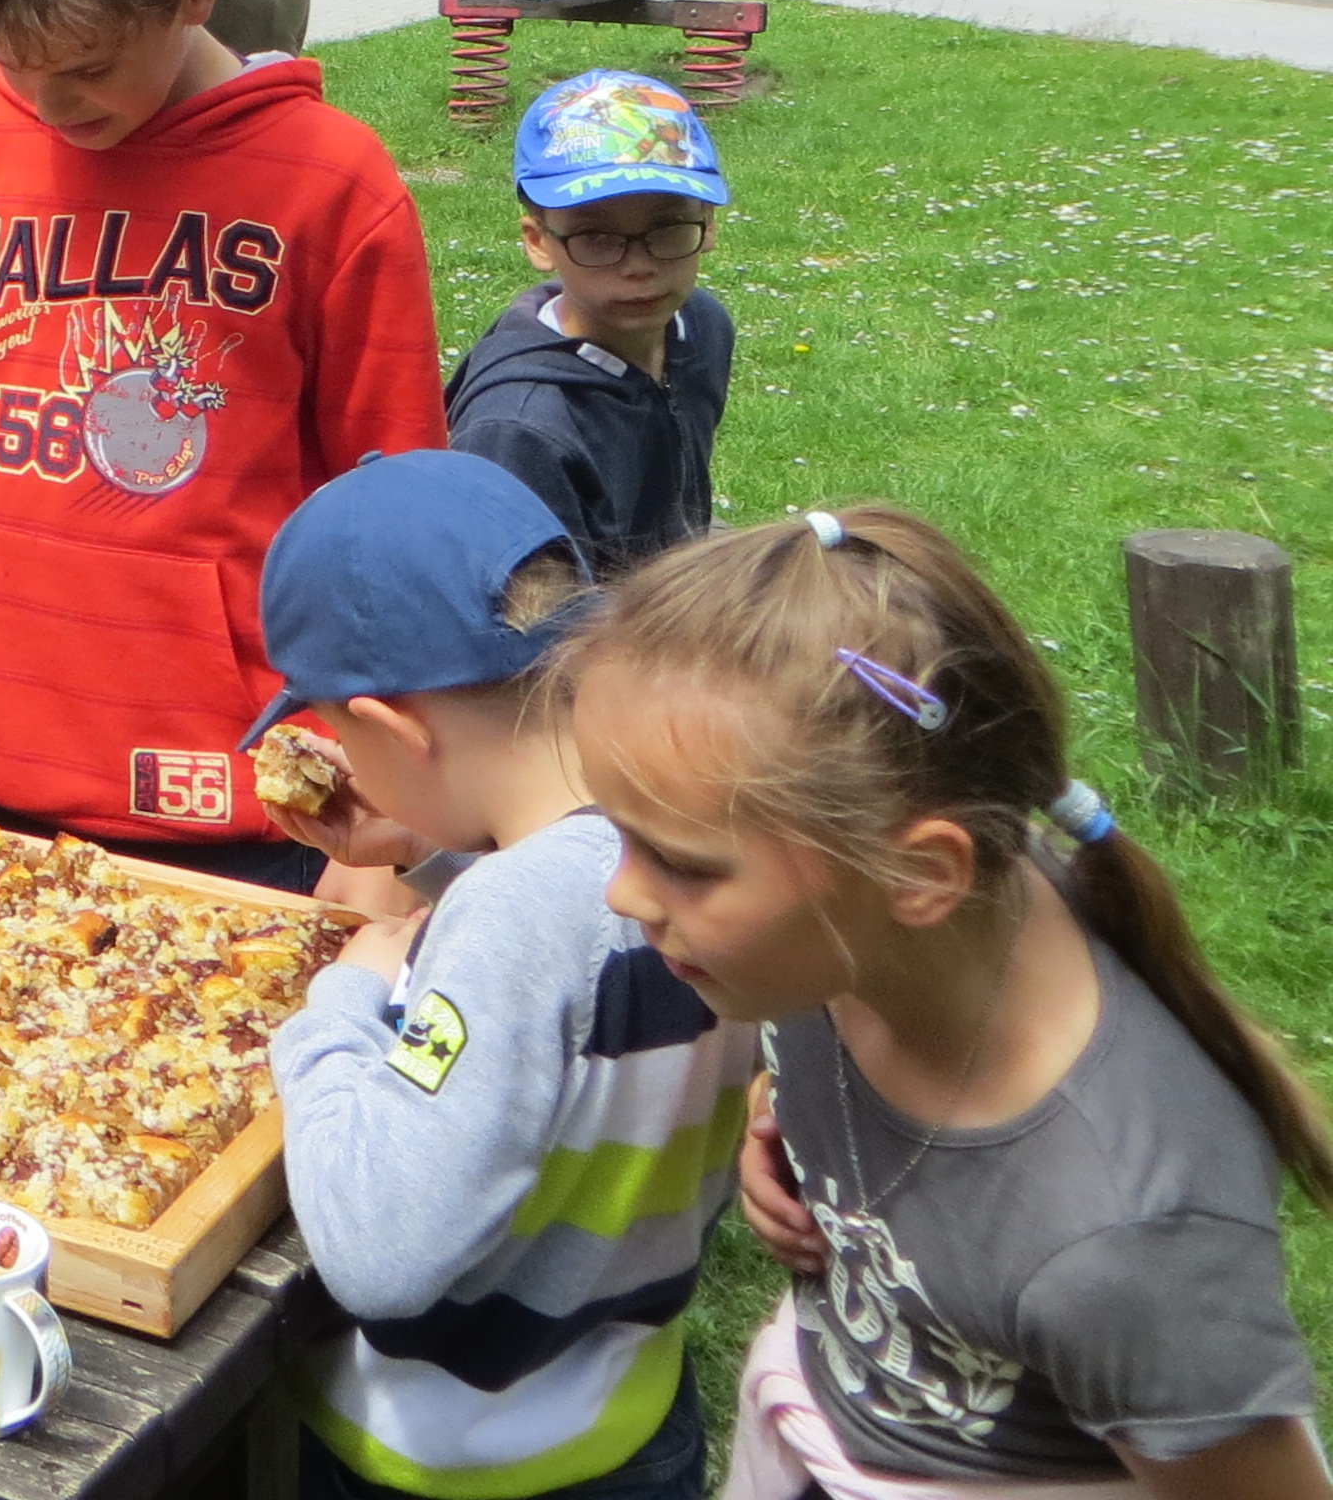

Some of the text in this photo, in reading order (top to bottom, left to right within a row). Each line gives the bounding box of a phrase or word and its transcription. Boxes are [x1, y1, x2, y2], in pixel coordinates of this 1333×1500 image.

[134, 438, 195, 486] Pro Edge
[158, 766, 226, 818] 56
